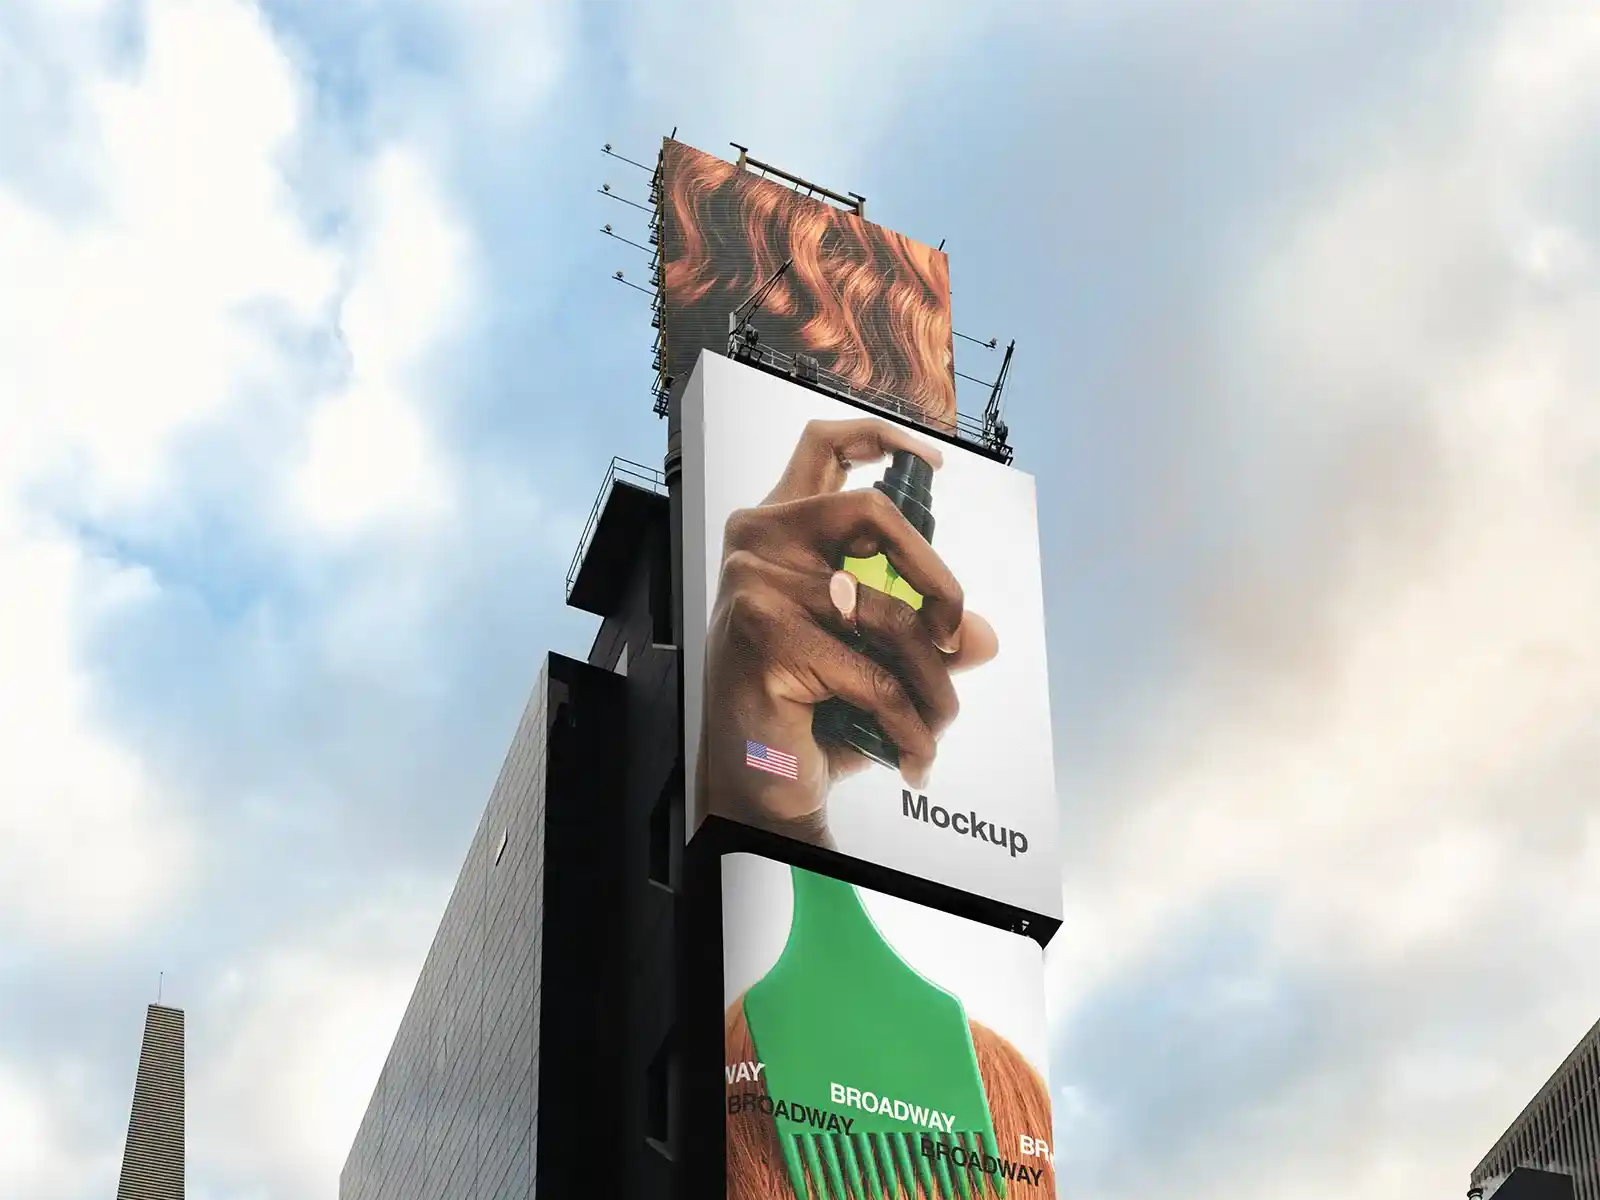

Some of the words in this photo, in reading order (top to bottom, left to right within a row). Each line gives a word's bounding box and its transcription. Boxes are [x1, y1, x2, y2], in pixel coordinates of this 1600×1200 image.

[902, 789, 1029, 857] Mockup
[728, 1094, 854, 1137] BROADWAY
[920, 1138, 1043, 1187] BROADWAY
[830, 1082, 956, 1133] BROADWAY
[1020, 1134, 1055, 1173] BR
